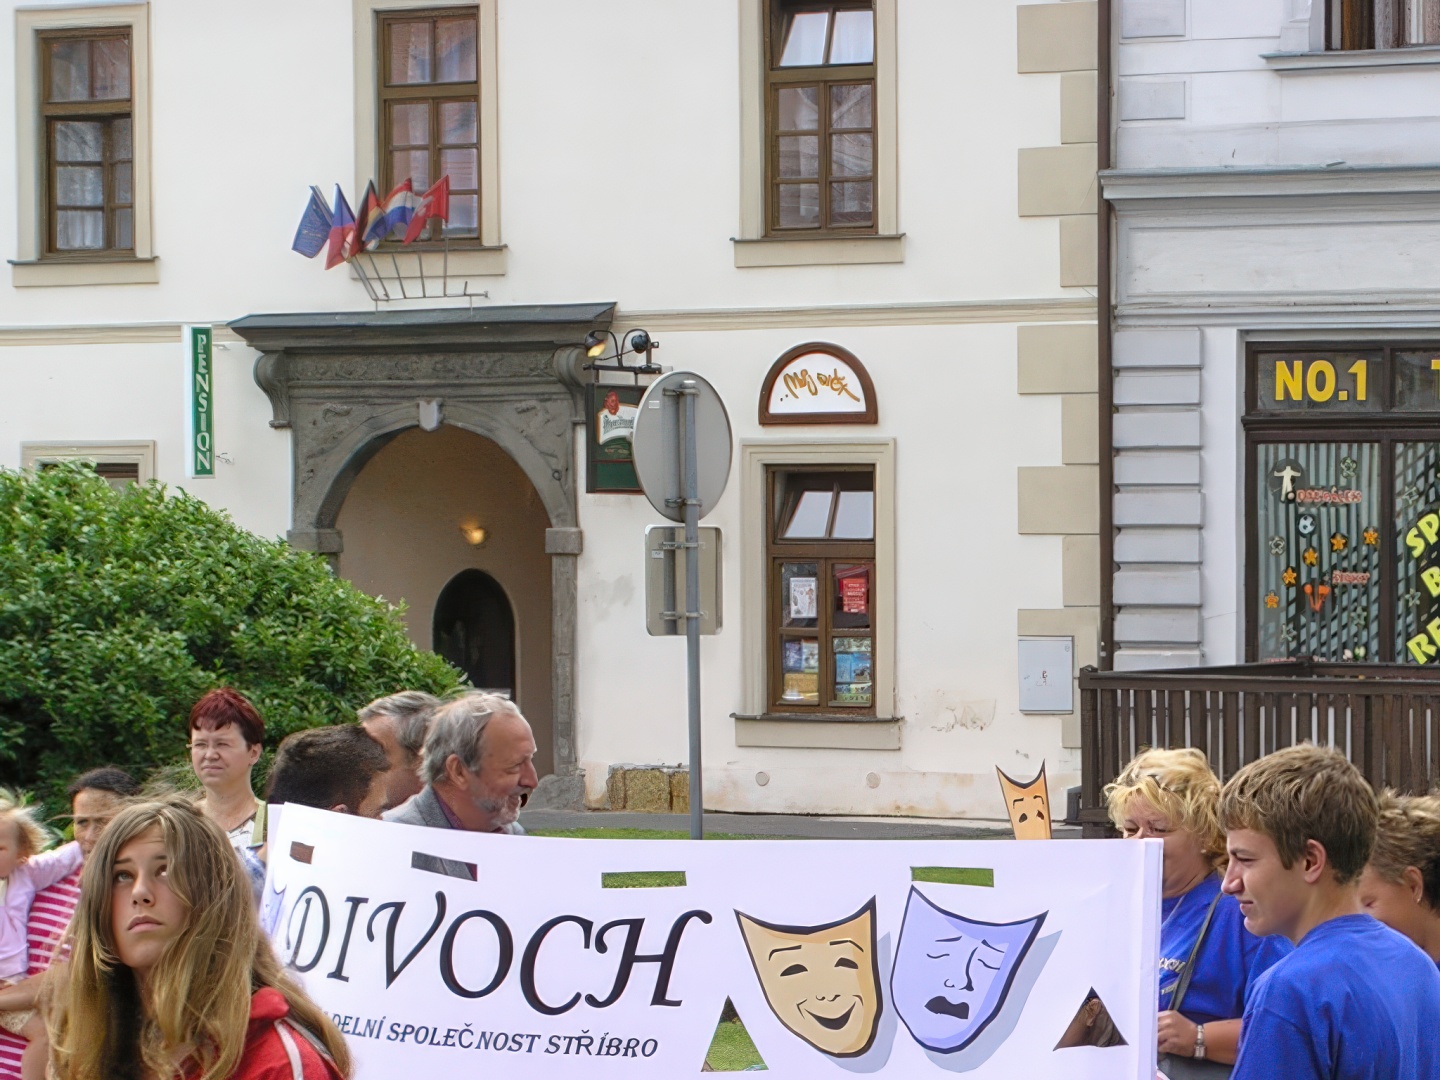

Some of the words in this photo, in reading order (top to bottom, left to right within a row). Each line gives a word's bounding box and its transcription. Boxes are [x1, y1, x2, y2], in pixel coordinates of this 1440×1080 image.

[196, 334, 211, 471] PENSION
[1275, 359, 1367, 402] NO.1
[287, 885, 712, 1015] DIVOCH
[326, 1011, 387, 1040] DELNÍ
[544, 1028, 659, 1058] STŘÍBRO
